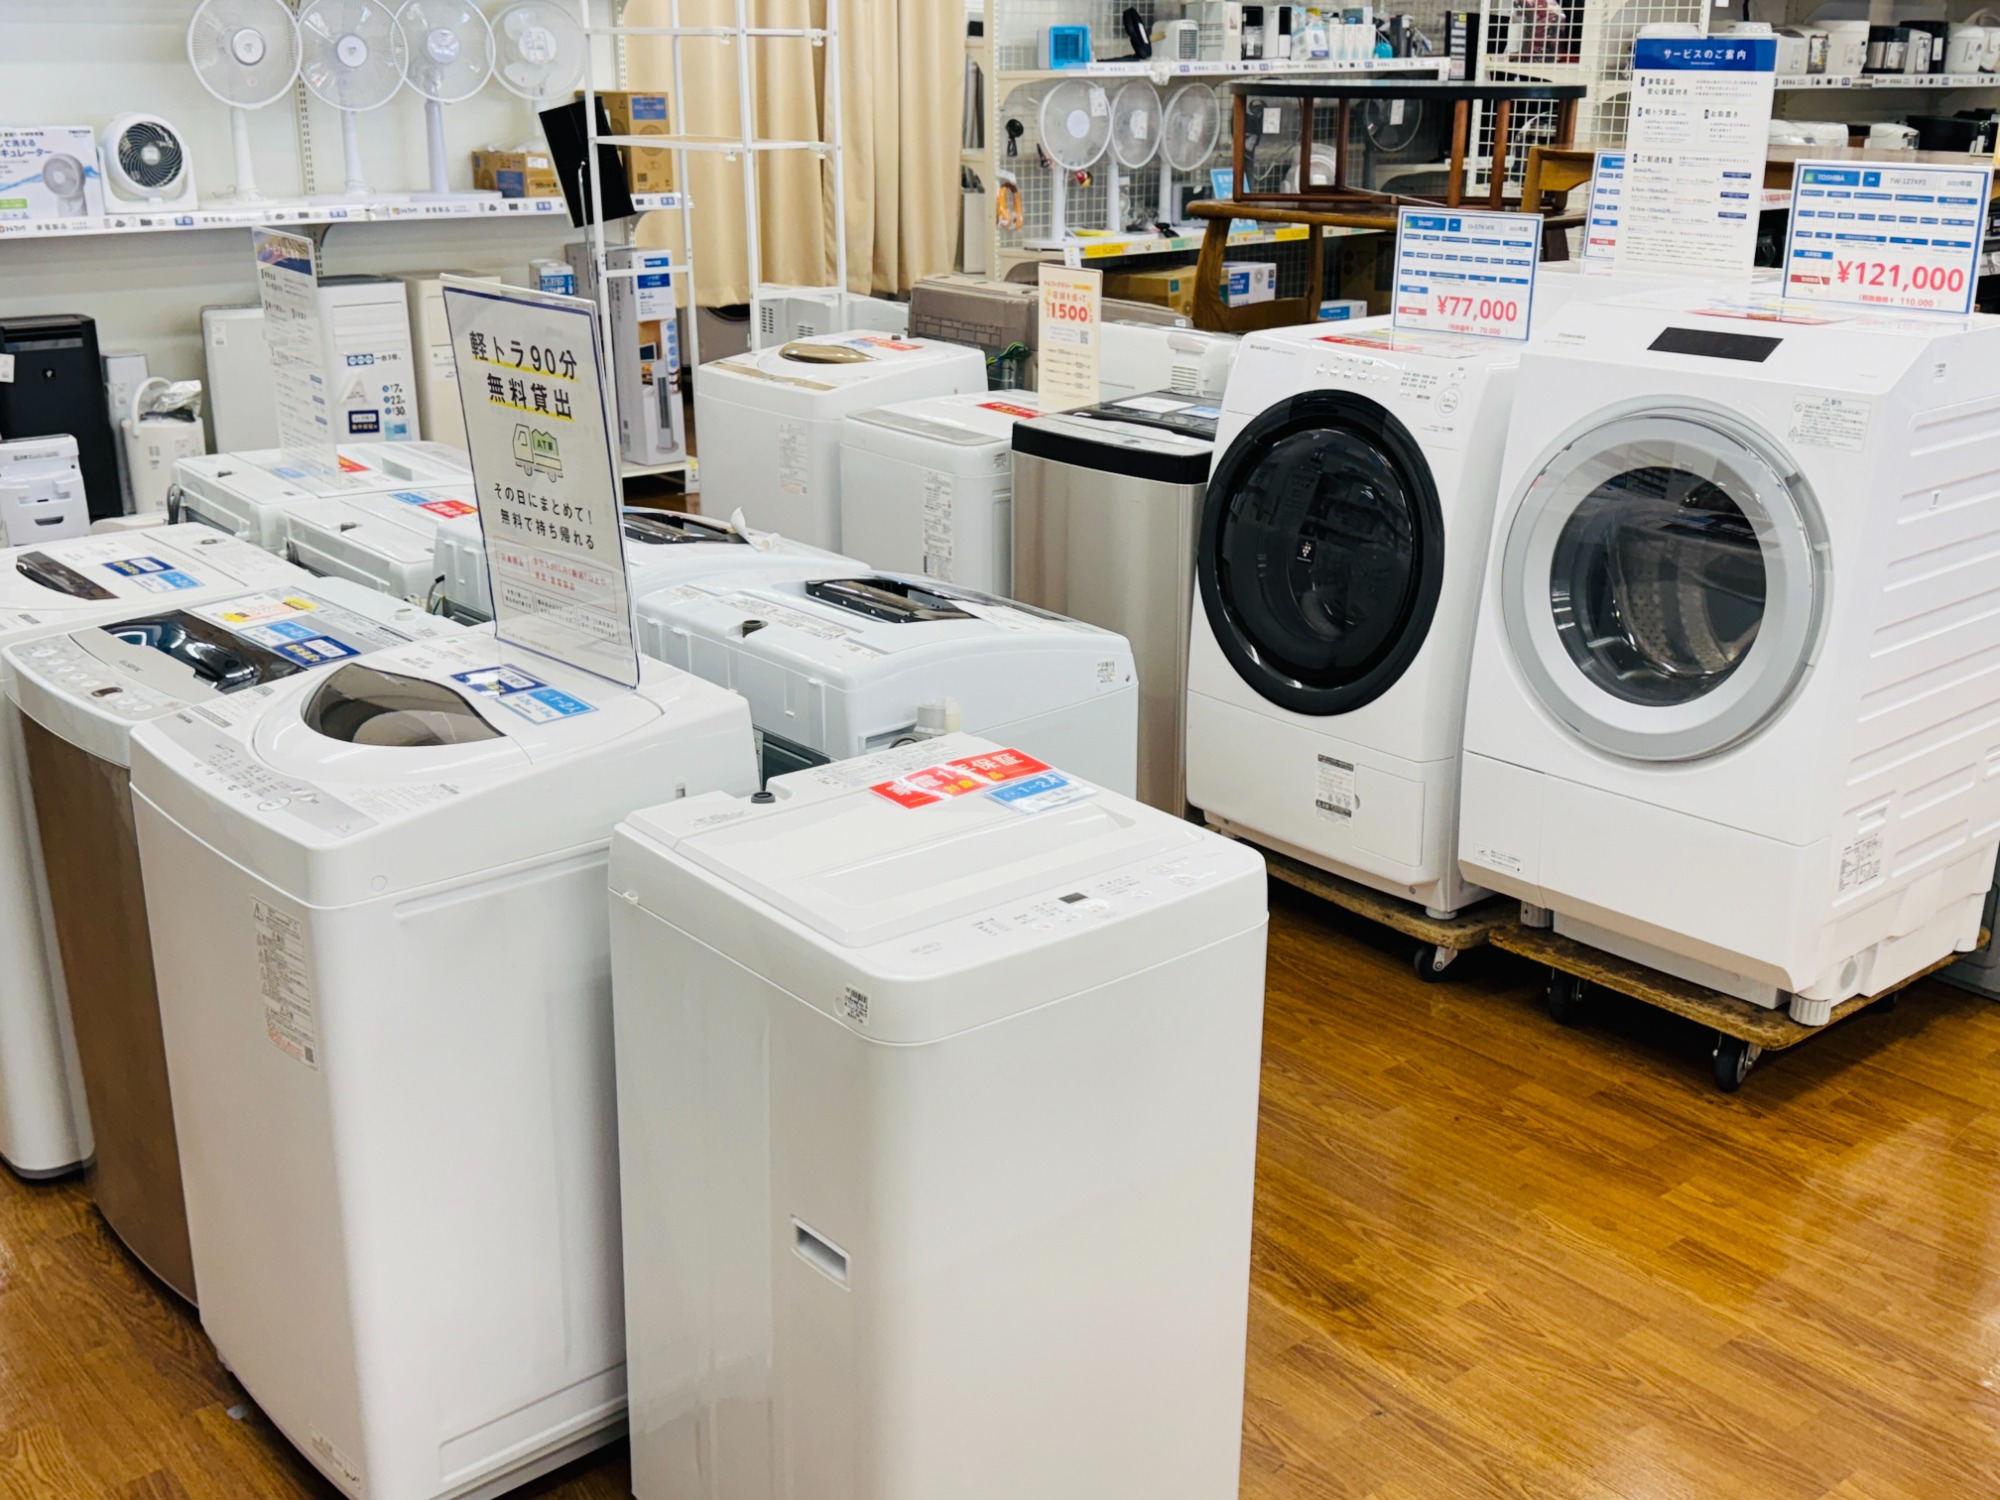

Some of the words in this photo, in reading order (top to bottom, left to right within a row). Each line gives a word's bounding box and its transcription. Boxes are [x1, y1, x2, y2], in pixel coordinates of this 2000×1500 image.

[1664, 48, 1747, 61] サービスのご案内
[1647, 88, 1689, 96] 安心保証付き
[1648, 78, 1676, 86] 家電全品
[1817, 174, 1845, 183] TOSHIBA
[1836, 260, 1964, 292] ¥121,000
[1437, 294, 1518, 322] ¥77,000
[469, 331, 577, 380] 軽トラ90分
[487, 373, 572, 420] 無料貸出
[500, 509, 594, 550] 無料で持ち帰れる
